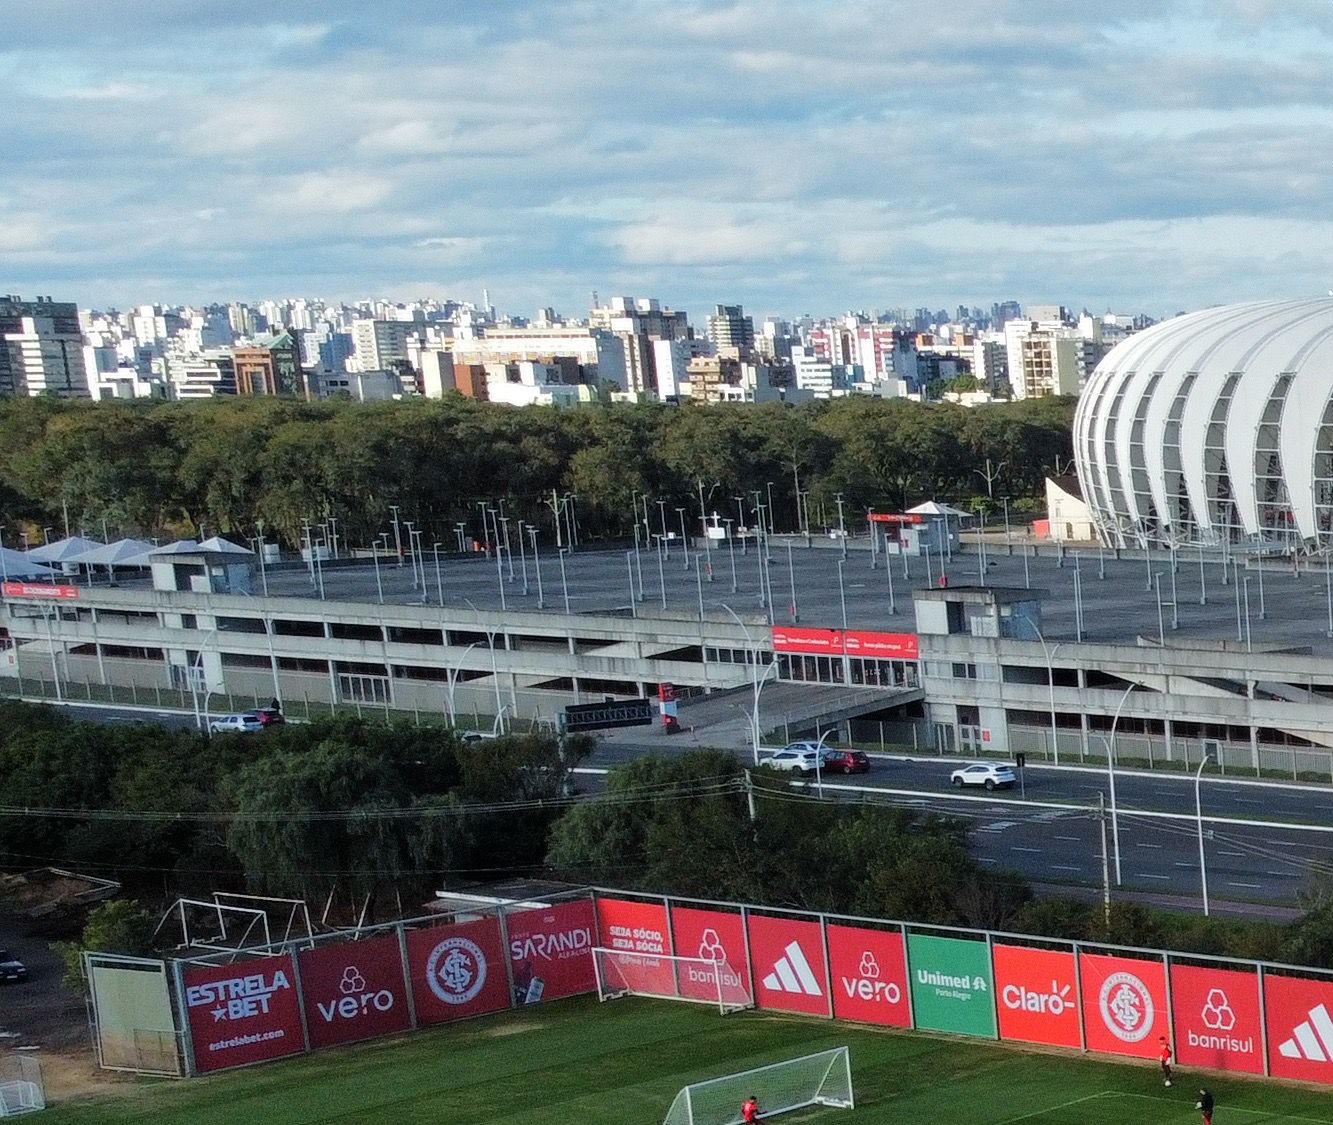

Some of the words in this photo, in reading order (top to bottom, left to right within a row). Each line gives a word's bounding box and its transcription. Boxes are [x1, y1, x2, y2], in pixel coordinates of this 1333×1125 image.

[511, 927, 592, 960] SARANDI
[187, 970, 290, 1007] ESTRELA
[688, 965, 742, 987] banisul
[841, 976, 901, 1004] vero
[918, 969, 970, 989] Unimed
[228, 993, 272, 1020] BET
[317, 990, 394, 1022] vero
[1002, 983, 1065, 1015] Claro
[1188, 1029, 1254, 1053] banrisul
